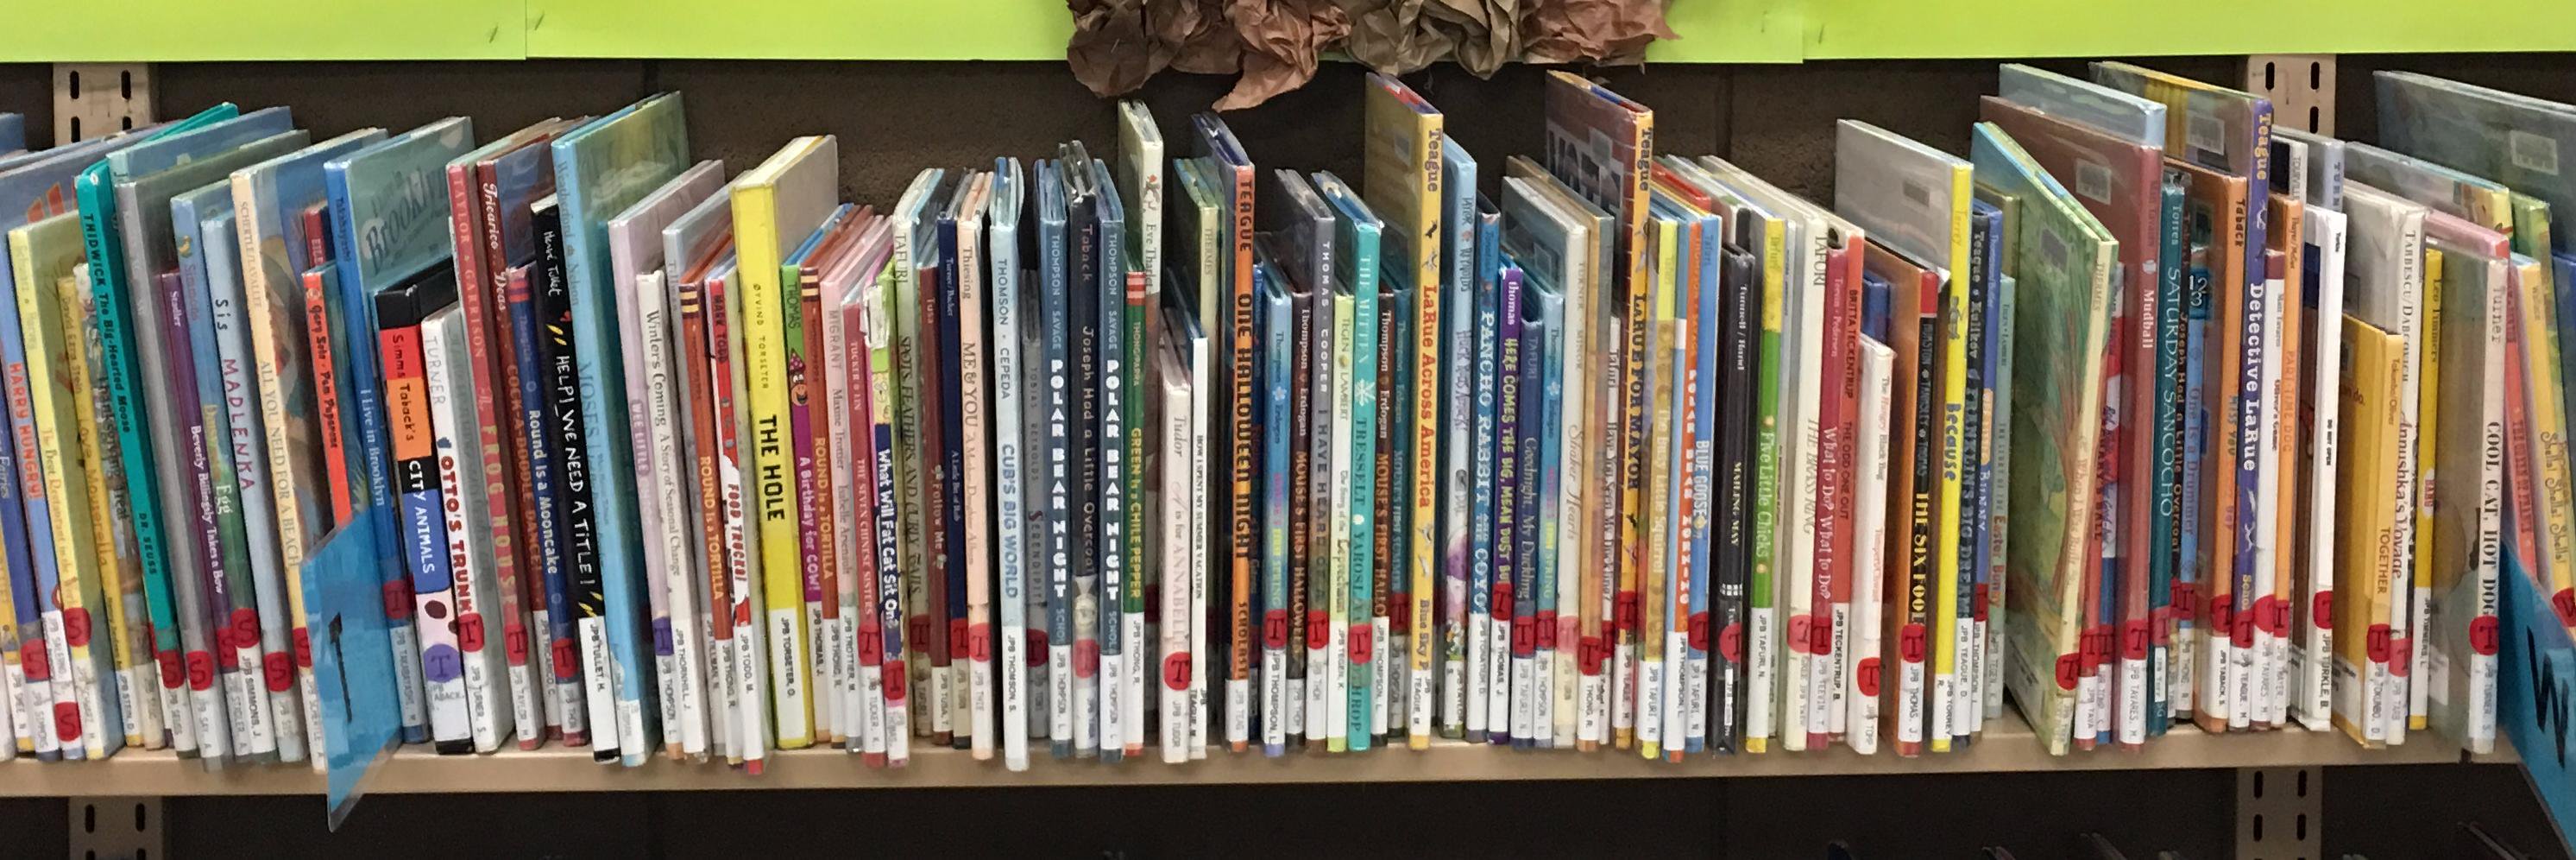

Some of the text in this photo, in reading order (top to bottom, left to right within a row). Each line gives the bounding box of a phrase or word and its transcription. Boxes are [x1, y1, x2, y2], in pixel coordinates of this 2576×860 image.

[454, 180, 484, 358] TAYLOR GARRISON
[484, 183, 499, 250] Tricarico
[894, 233, 909, 283] TAFURI
[1812, 236, 1828, 287] TAFURI
[84, 214, 130, 433] THIDWICK The Big-Hearted Moose
[788, 283, 801, 328] THOMAS
[960, 247, 973, 299] Thiesing
[1628, 127, 1653, 490] Teague FOR MAYOR
[2092, 262, 2105, 312] THERMES
[2142, 289, 2155, 348] Mudball
[2243, 113, 2271, 471] Teague Detective LaRue
[426, 336, 445, 404] TURNER
[828, 311, 841, 369] MIGRANT
[998, 259, 1011, 400] THOMSON CEPEDA
[1080, 224, 1095, 490] Taback Joseph Had Little
[1236, 180, 1252, 560] TEAGUE ONE HALLOWEEN NIGHT
[1318, 242, 1331, 471] THOMAS COOPER HAVE
[1845, 289, 1857, 399] BRITTA TECKENTRUP
[2160, 205, 2182, 517] Torres SATURDAY SANCOCHO
[9, 363, 30, 418] HARRY
[216, 300, 255, 490] Sis MADLENKA
[399, 383, 416, 441] Taback's
[576, 360, 601, 437] MOSES
[1050, 234, 1065, 598] THOMPSON SAVAGE POLAR BEAR NIGHT
[1106, 233, 1120, 600] THOMPSON SAVAGE POLAR BEAR NIGHT
[1173, 415, 1187, 458] Tudor
[1376, 311, 1391, 561] Thompson FIRST
[1417, 129, 1441, 656] Teague LaRue Across America Blue Sky
[1477, 311, 1494, 507] PANCHO RABBIT
[1500, 281, 1519, 523] thomas HERE COMES THE MEAN
[1959, 231, 1986, 539] Teague Kulikov BIG
[19, 426, 42, 498] HUNGRY!
[261, 362, 299, 567] ALL NEED FOR A BEACH
[365, 430, 387, 507] in Brooklyn
[528, 411, 559, 573] Round Mooncake
[563, 412, 585, 514] WE NEED A
[652, 372, 682, 576] Coming Story of Seasonal Change
[759, 414, 785, 522] THE HOLE
[1355, 420, 1367, 505] TRESSELT
[1693, 440, 1710, 516] BLUE GOOSE
[1756, 432, 1773, 557] Five Little Chicks
[1818, 316, 1842, 598] Pedersen What to Do? What to Do?
[1943, 403, 1961, 482] Because
[2481, 286, 2504, 615] Turner COOL CAT, HOT DOG
[139, 513, 157, 575] DR. SEUSS
[191, 426, 224, 594] Beverly Takes Bow
[214, 484, 232, 515] Egg
[408, 461, 435, 573] CITY ANIMALS
[441, 456, 472, 612] OTTO'S TRUNK
[701, 457, 723, 599] ROUND TORTILLA
[727, 484, 740, 516] FOOD
[799, 457, 820, 590] A Birthday COW!
[878, 449, 898, 598] What Will Fat Cat Sit
[1001, 445, 1018, 598] CUB'S BIG WORLD
[1130, 428, 1142, 598] GREEN CHILE PEPPER
[1294, 522, 1306, 559] FIRST
[1912, 492, 1930, 566] THE SIX
[1992, 515, 2006, 559] Easter
[2377, 527, 2391, 594] TOGETHER
[590, 643, 601, 681] TULLET,
[782, 636, 794, 686] TORSETER,
[1758, 615, 1767, 633] JPB
[1833, 610, 1843, 691] JPB TECKENTRUP,
[2319, 634, 2331, 699] JPB TURKLE,
[1008, 654, 1017, 703] THOMSON,
